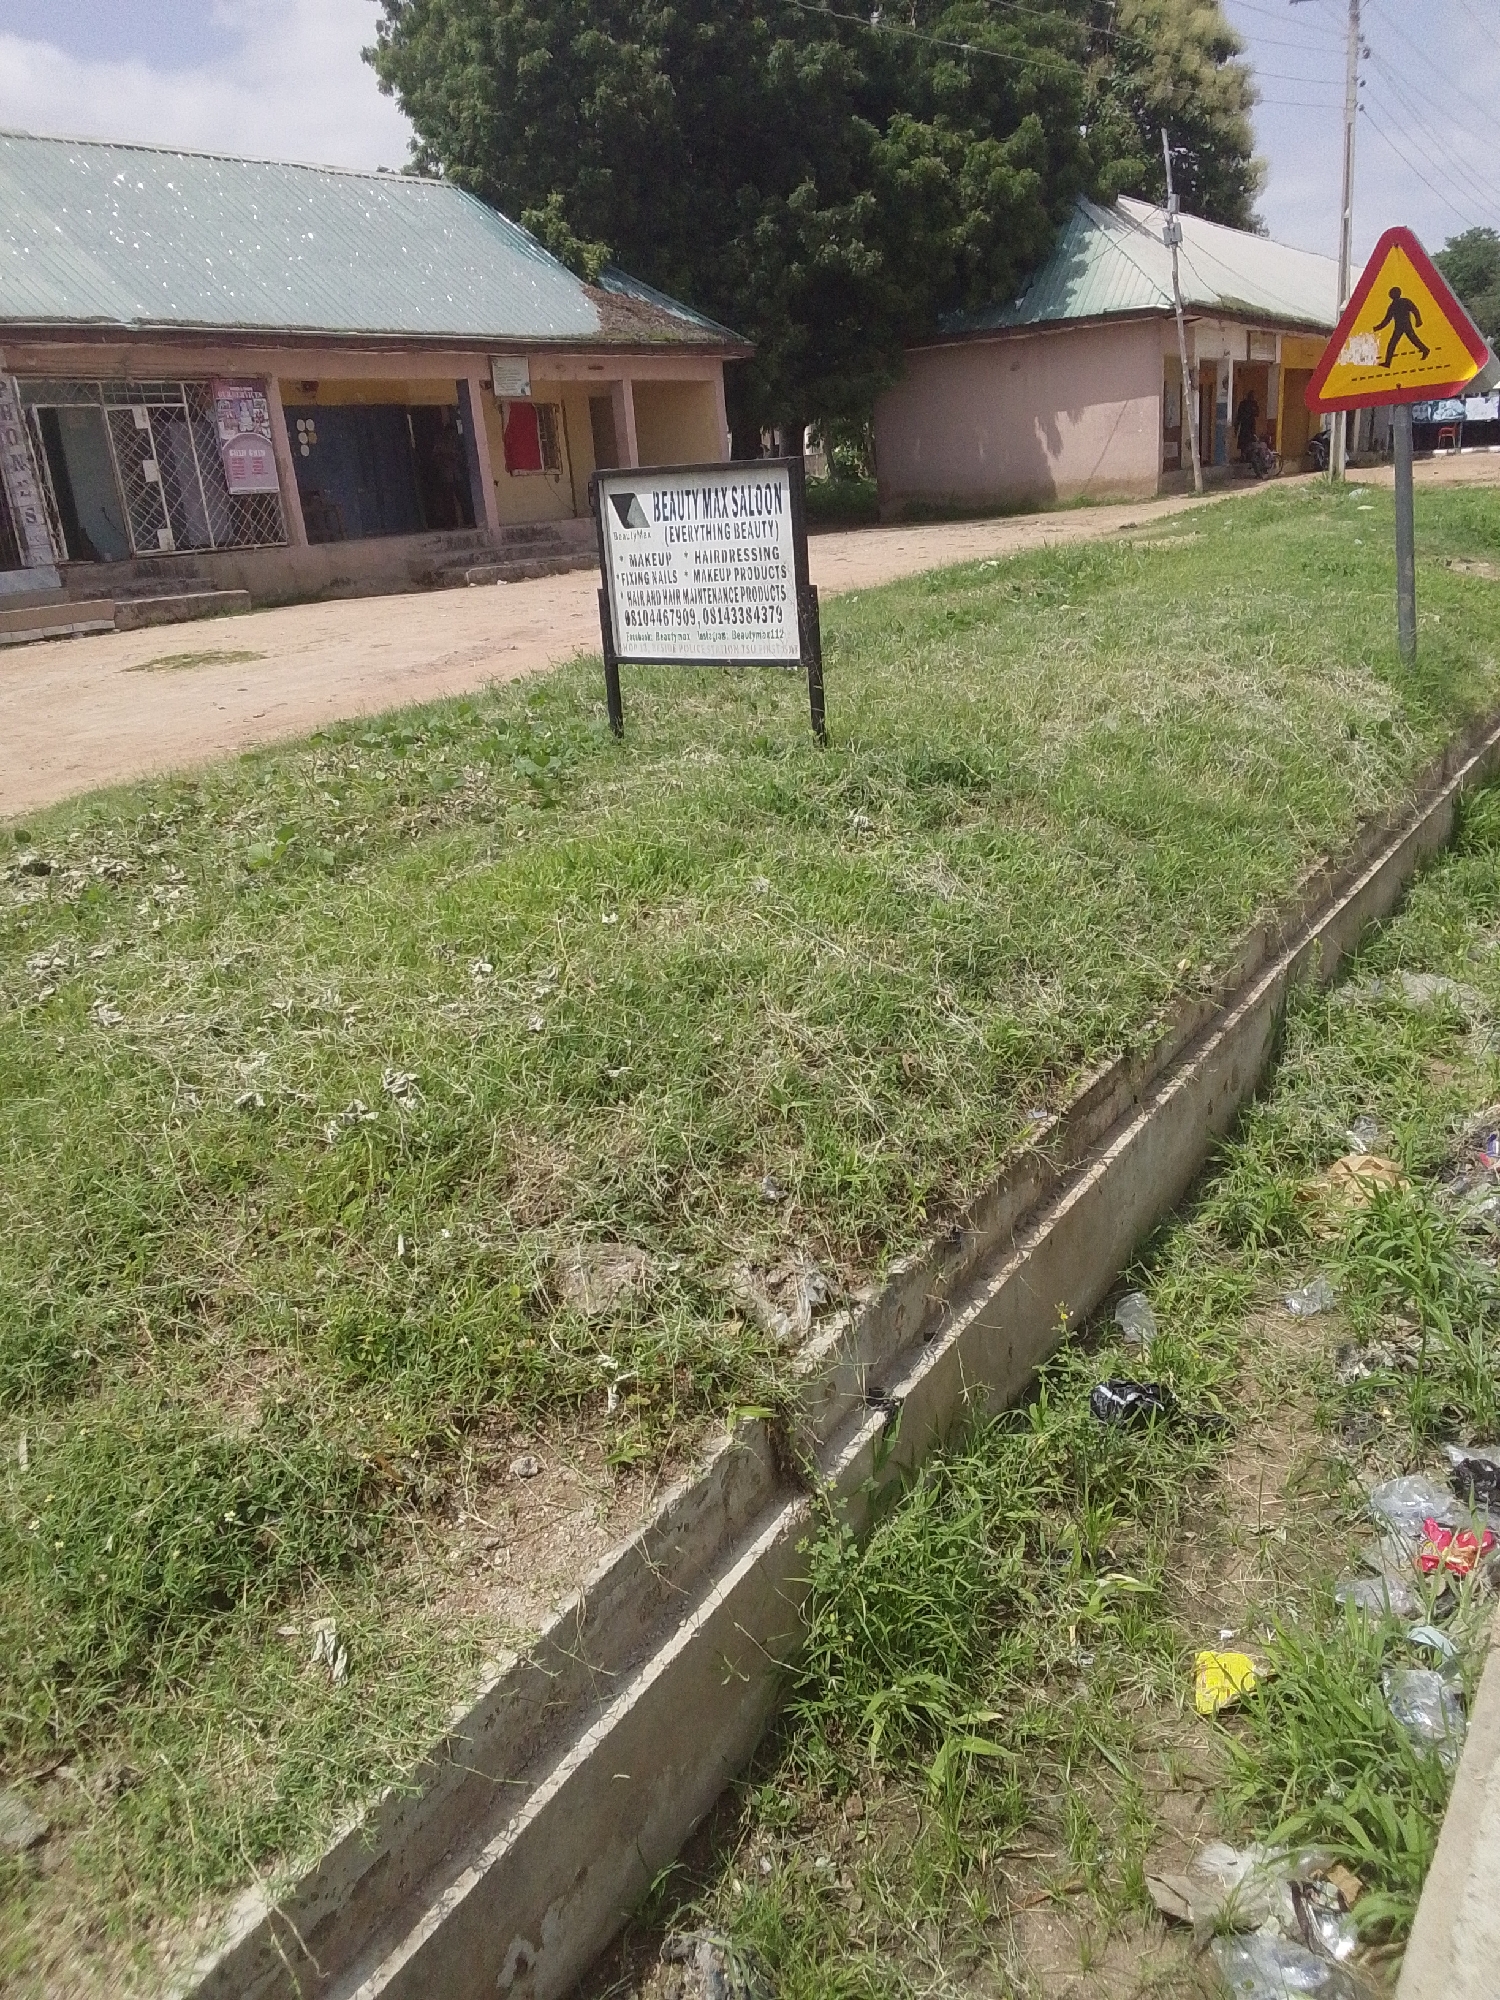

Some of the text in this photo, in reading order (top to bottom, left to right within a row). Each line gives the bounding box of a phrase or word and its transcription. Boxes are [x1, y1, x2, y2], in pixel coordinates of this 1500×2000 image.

[653, 482, 783, 522] BEAUTY MAX SALOON
[734, 520, 779, 542] BEAUTY)
[629, 552, 672, 567] MAKEUP
[695, 547, 780, 564] HAIRDRESSING
[621, 570, 678, 586] FIXING NAILS
[693, 565, 787, 584] MAKEUP PRODUCTS
[627, 590, 645, 606] HAIR
[646, 590, 661, 606] AND
[663, 589, 680, 605] HAIR
[740, 584, 786, 602] PRODUCTS
